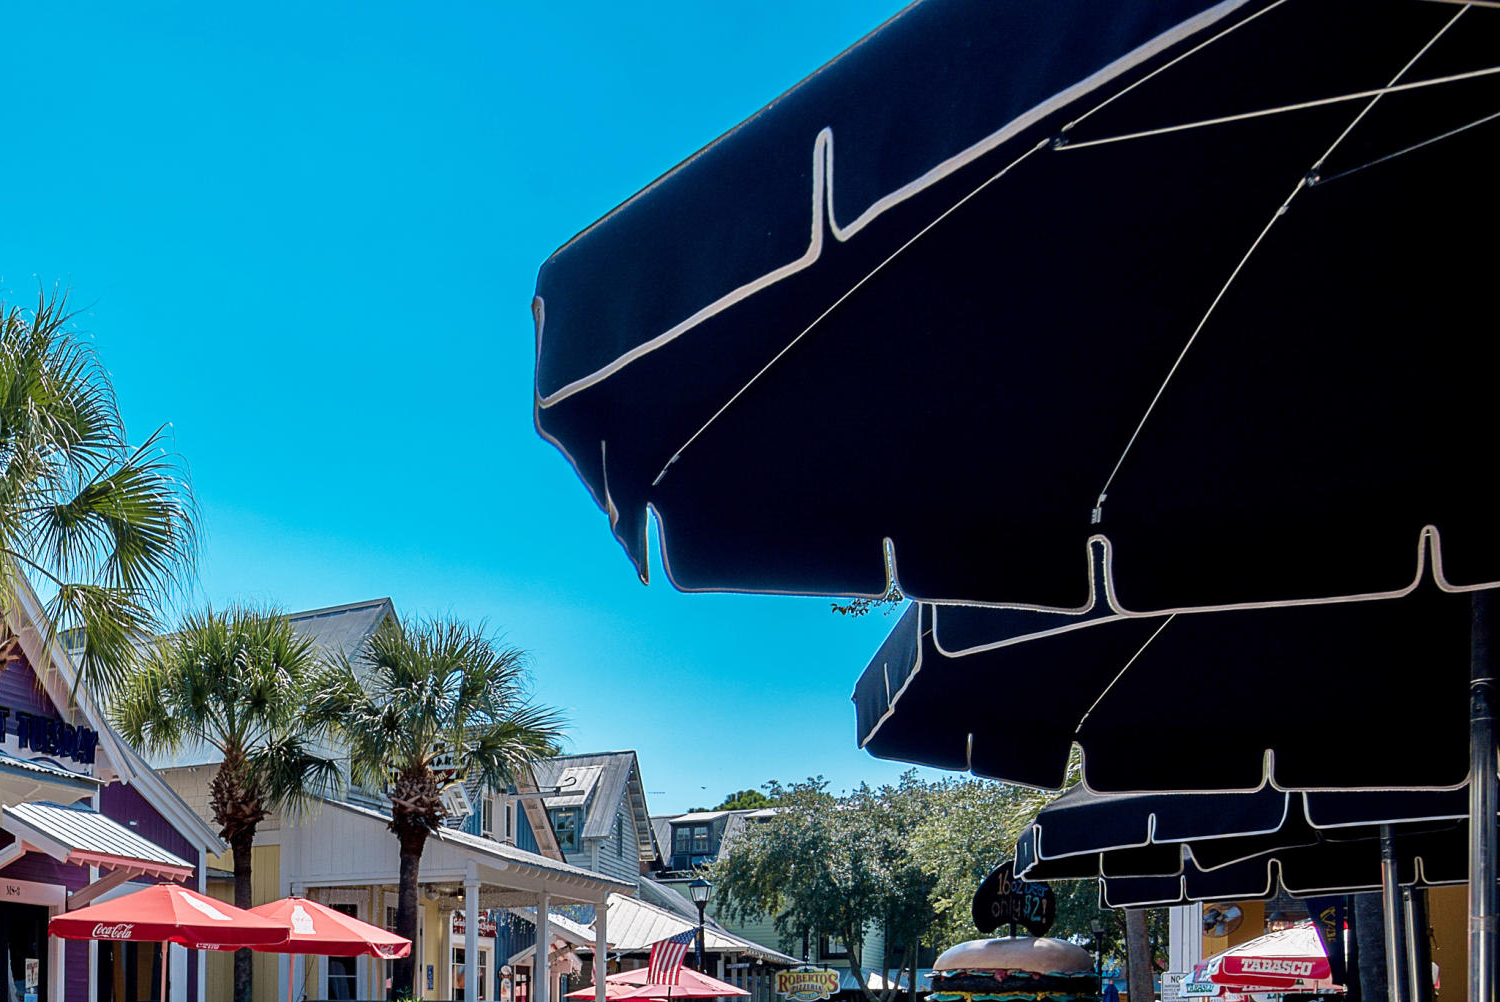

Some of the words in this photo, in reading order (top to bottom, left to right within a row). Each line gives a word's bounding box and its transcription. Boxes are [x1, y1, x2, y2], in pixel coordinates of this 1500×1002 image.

[15, 712, 99, 764] TUESDAY
[997, 870, 1010, 895] 16
[1241, 958, 1313, 976] TABASCO
